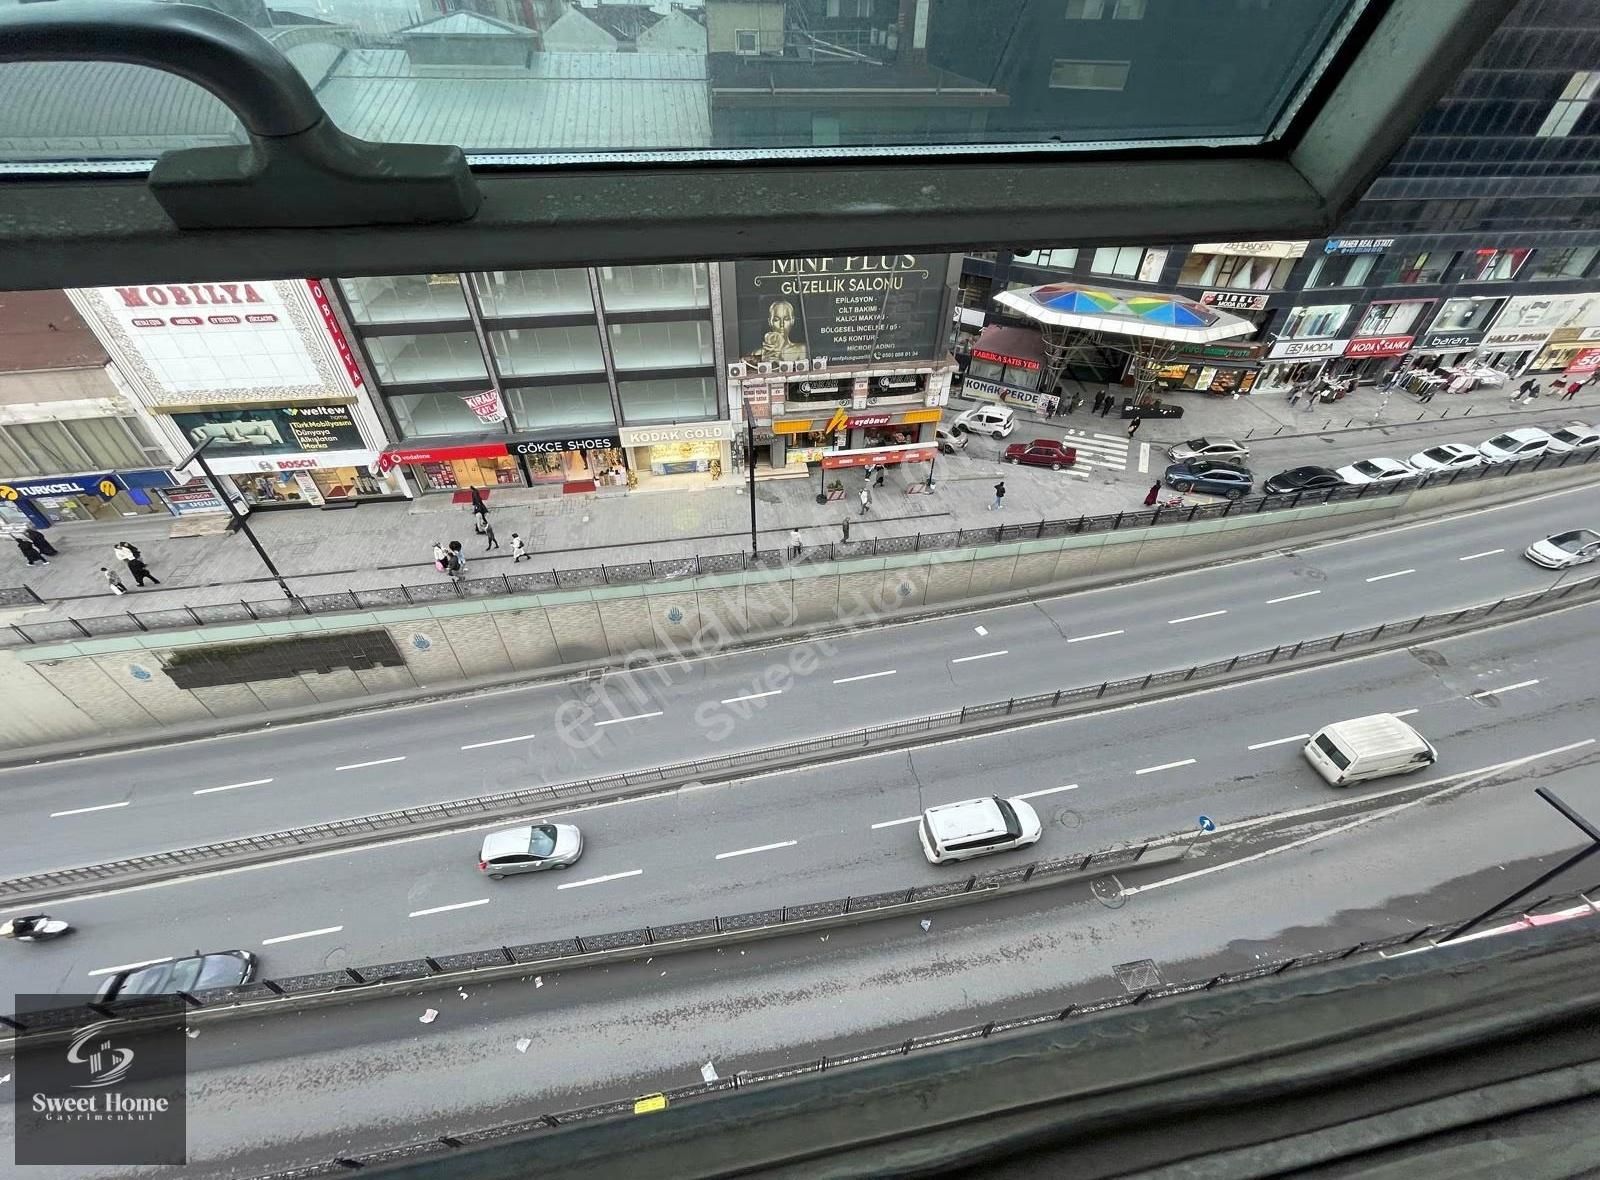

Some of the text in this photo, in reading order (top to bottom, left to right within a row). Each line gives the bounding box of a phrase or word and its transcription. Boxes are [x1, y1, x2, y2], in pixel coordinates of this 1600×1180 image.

[781, 276, 904, 295] GÜZELLİK SALONU
[835, 296, 874, 304] EPİLASYON
[838, 306, 852, 314] CİLT
[821, 325, 855, 333] BÖLGESEL
[1432, 337, 1469, 345] baran
[1303, 343, 1333, 352] MODA
[1351, 343, 1375, 352] MODA
[966, 379, 1039, 404] KONAK PERDE
[300, 406, 345, 416] weltew
[630, 427, 722, 443] KODAK GOLD
[517, 438, 612, 455] GÖKÇE SHOES
[277, 459, 318, 470] BOSCH
[16, 482, 85, 496] TURKCELL
